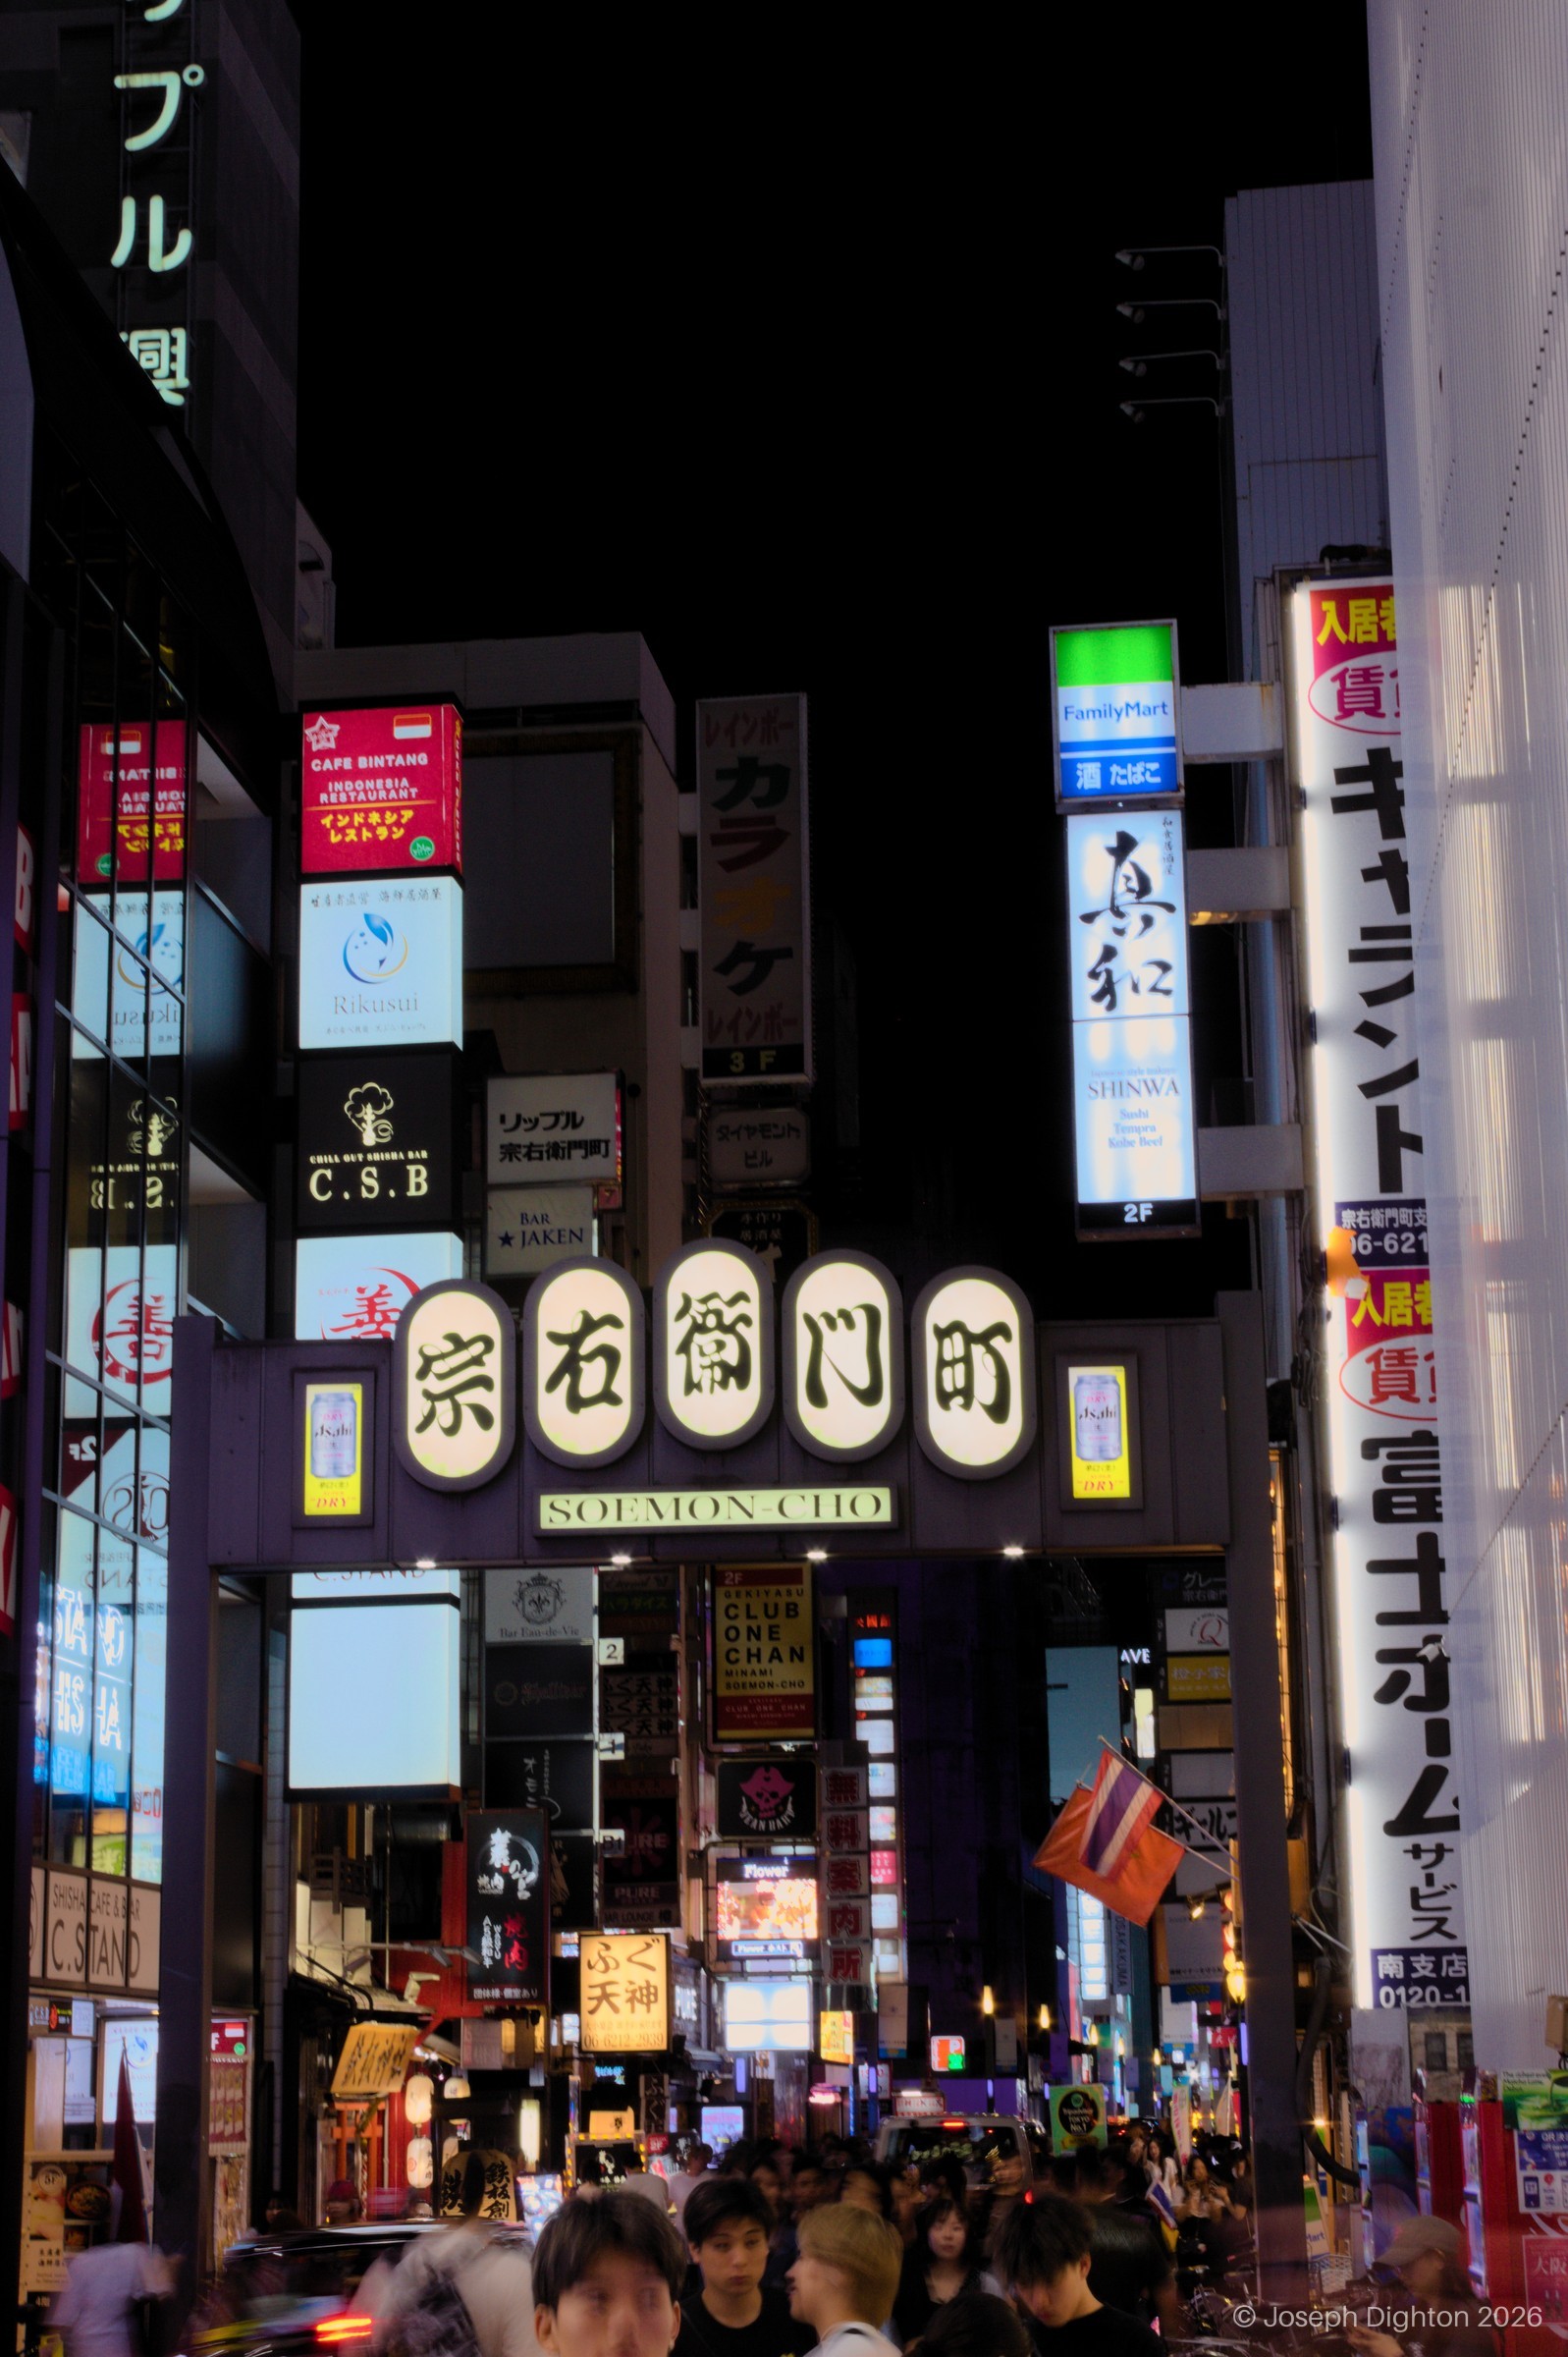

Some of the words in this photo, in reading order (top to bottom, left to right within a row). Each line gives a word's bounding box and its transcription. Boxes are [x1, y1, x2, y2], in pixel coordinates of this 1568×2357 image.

[1336, 665, 1401, 721] 賃
[1064, 700, 1168, 722] FamilyMart
[705, 708, 794, 748] レインボー
[311, 757, 351, 772] CAFE
[358, 752, 428, 769] BINTANG
[328, 778, 409, 792] INDONESIA
[1076, 762, 1102, 790] 酒
[1109, 761, 1162, 786] たばこ
[320, 788, 418, 803] RESTAURANT
[321, 809, 414, 829] インドネシア
[331, 826, 405, 844] レストラン
[709, 756, 794, 996] カラオケ
[334, 992, 418, 1014] Rikusui
[707, 1006, 797, 1044] レインボー
[1088, 1077, 1179, 1100] SHINWA
[500, 1111, 584, 1132] リップル
[1120, 1108, 1149, 1120] Sushi
[500, 1139, 611, 1163] 宗右衛門町
[1108, 1136, 1136, 1148] Kobe
[310, 1155, 341, 1164] CHILL
[367, 1152, 405, 1161] SHISHA
[408, 1150, 428, 1159] BAR
[744, 1150, 773, 1169] ビル
[520, 1212, 551, 1226] BAR
[1124, 1203, 1153, 1223] 2F
[521, 1228, 583, 1249] JAKEN
[416, 1292, 1012, 1437] 宗右衛門町
[1365, 1349, 1439, 1403] 賃
[1079, 1405, 1116, 1420] Asahi
[315, 1424, 352, 1438] Asahi
[1084, 1481, 1115, 1492] DRY
[316, 1498, 347, 1508] DRY
[548, 1492, 883, 1524] SOEMON-CHO
[725, 1571, 743, 1585] 2F
[725, 1589, 804, 1599] GEKIYASU
[725, 1602, 799, 1619] CLUB
[500, 1627, 518, 1638] Bar
[725, 1624, 781, 1642] ONE
[607, 1644, 618, 1659] 2
[725, 1646, 805, 1665] CHAN
[726, 1669, 773, 1677] MINAMI
[726, 1680, 805, 1690] SOEMON-CHO
[626, 1833, 668, 1849] URE
[744, 1864, 788, 1878] Flower
[53, 1884, 85, 1911] SHISHA
[615, 1887, 660, 1898] PURE
[52, 1919, 140, 1979] C.STAND
[587, 1939, 660, 1972] ふぐ
[1378, 1952, 1467, 1980] 南支店
[588, 1980, 658, 2014] 天神
